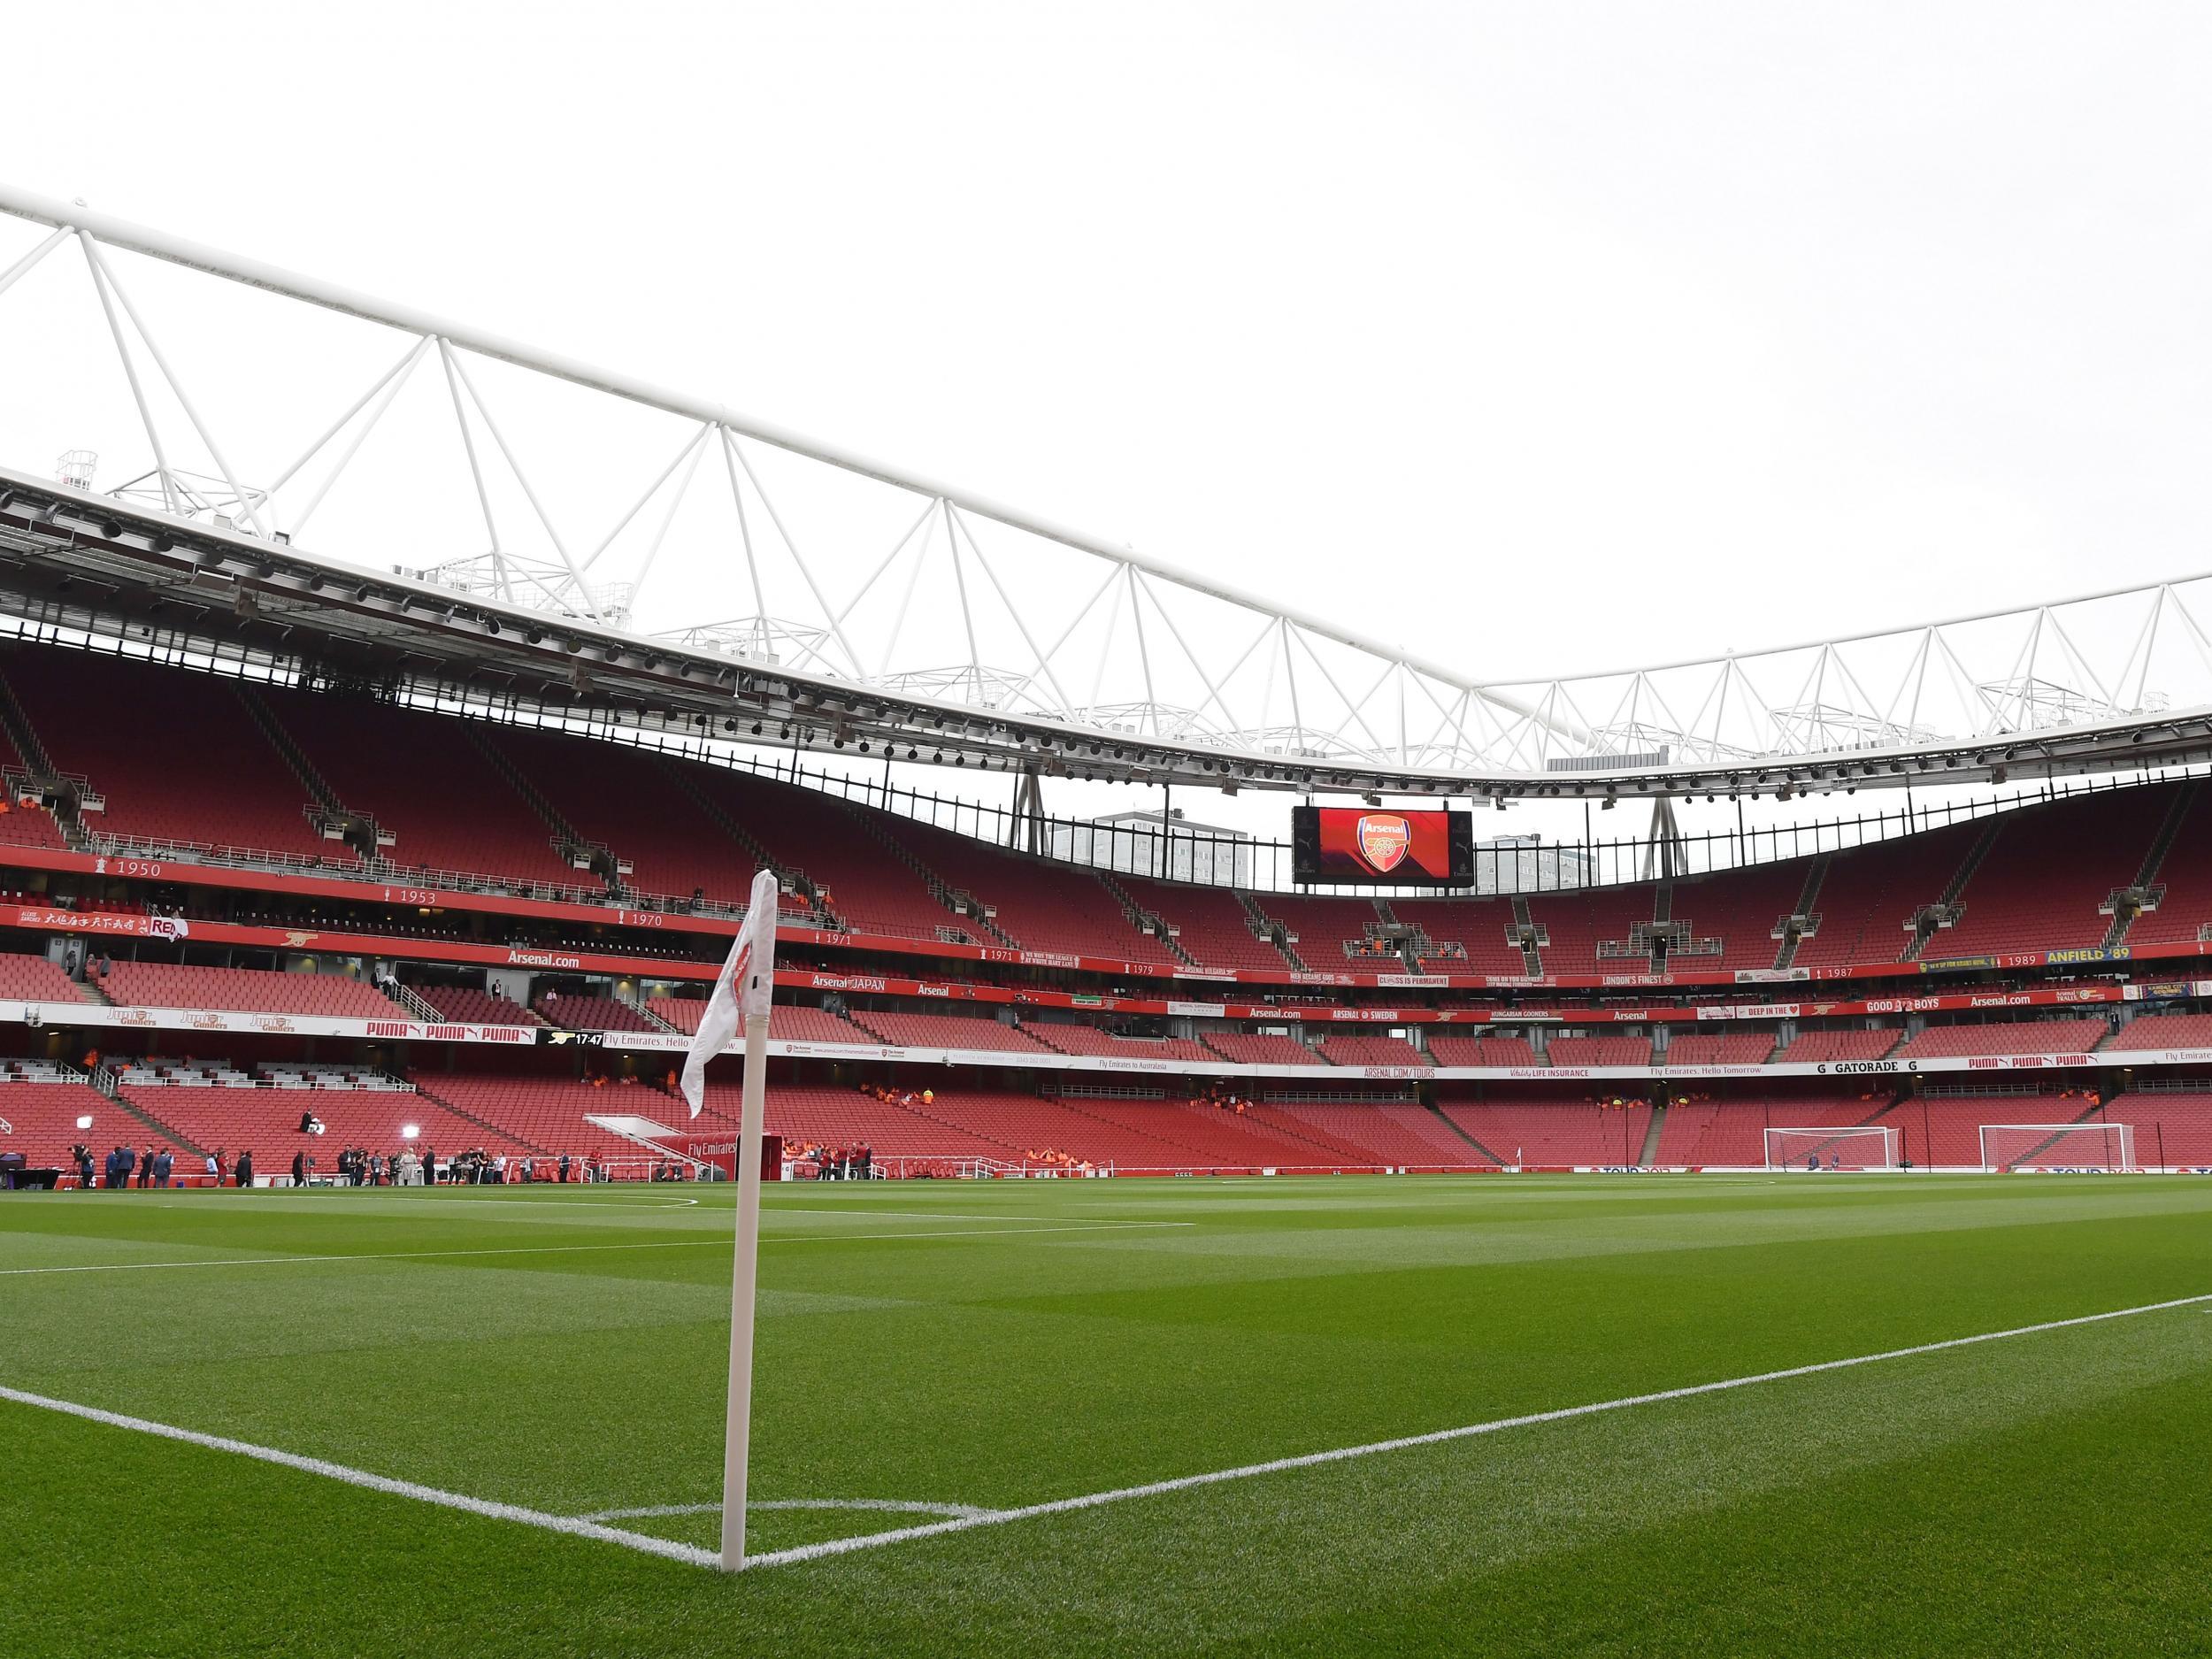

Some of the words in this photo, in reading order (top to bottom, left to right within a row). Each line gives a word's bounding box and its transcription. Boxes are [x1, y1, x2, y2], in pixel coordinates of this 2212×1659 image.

[1365, 821, 1404, 834] Arsenal
[118, 862, 161, 877] 1950
[400, 890, 436, 904] 1953
[632, 914, 662, 927] 1970
[826, 933, 851, 945] 1971
[508, 951, 579, 968] Arsenal.com
[991, 950, 1012, 962] 1971
[2008, 955, 2036, 966] 1989
[2047, 950, 2104, 964] ANFIELD
[2109, 947, 2130, 959] '89
[1133, 964, 1153, 975] 1979
[1828, 968, 1853, 978] 1987
[812, 975, 847, 988] Arsenal
[853, 978, 886, 991] JAPAN
[1602, 976, 1637, 985] LONDON'S
[1638, 975, 1663, 984] FINEST
[918, 984, 949, 997] Arsenal
[1867, 1001, 1893, 1012] GOOD
[1914, 998, 1939, 1010] BOYS
[1971, 995, 2031, 1007] Arsenal.com
[1250, 1008, 1301, 1019] Arsenal.com
[1333, 1010, 1359, 1019] ARSENAL
[1371, 1010, 1398, 1020] SWEDEN
[1614, 1010, 1647, 1020] Arsenal
[1766, 1007, 1773, 1016] IN
[1775, 1006, 1786, 1015] THE
[120, 1016, 157, 1026] Gunners
[193, 1019, 227, 1029] Gunners
[262, 1024, 295, 1033] Gunners
[366, 1022, 408, 1037] PUMA
[426, 1025, 465, 1040] PUMA
[481, 1028, 520, 1042] PUMA
[575, 1034, 603, 1046] 17:47
[603, 1034, 618, 1047] Fly
[621, 1036, 663, 1046] Emirates.
[666, 1037, 688, 1048] Hello
[1969, 1058, 1998, 1069] PUMA
[2012, 1056, 2043, 1067] PUMA
[2056, 1055, 2087, 1065] PUMA
[2165, 1052, 2179, 1062] Fly
[2180, 1050, 2212, 1061] Emirate
[1099, 1060, 1108, 1070] Fly
[1139, 1061, 1167, 1070] Australasia
[1835, 1062, 1898, 1073] GATORADE
[1363, 1068, 1435, 1079] ARSENAL.COM/TOURS
[1509, 1068, 1532, 1079] Vitality
[1650, 1068, 1663, 1078] Fly
[1724, 1065, 1763, 1074] Tomorrow.
[688, 1143, 702, 1157] Fly
[703, 1142, 736, 1156] Emirates
